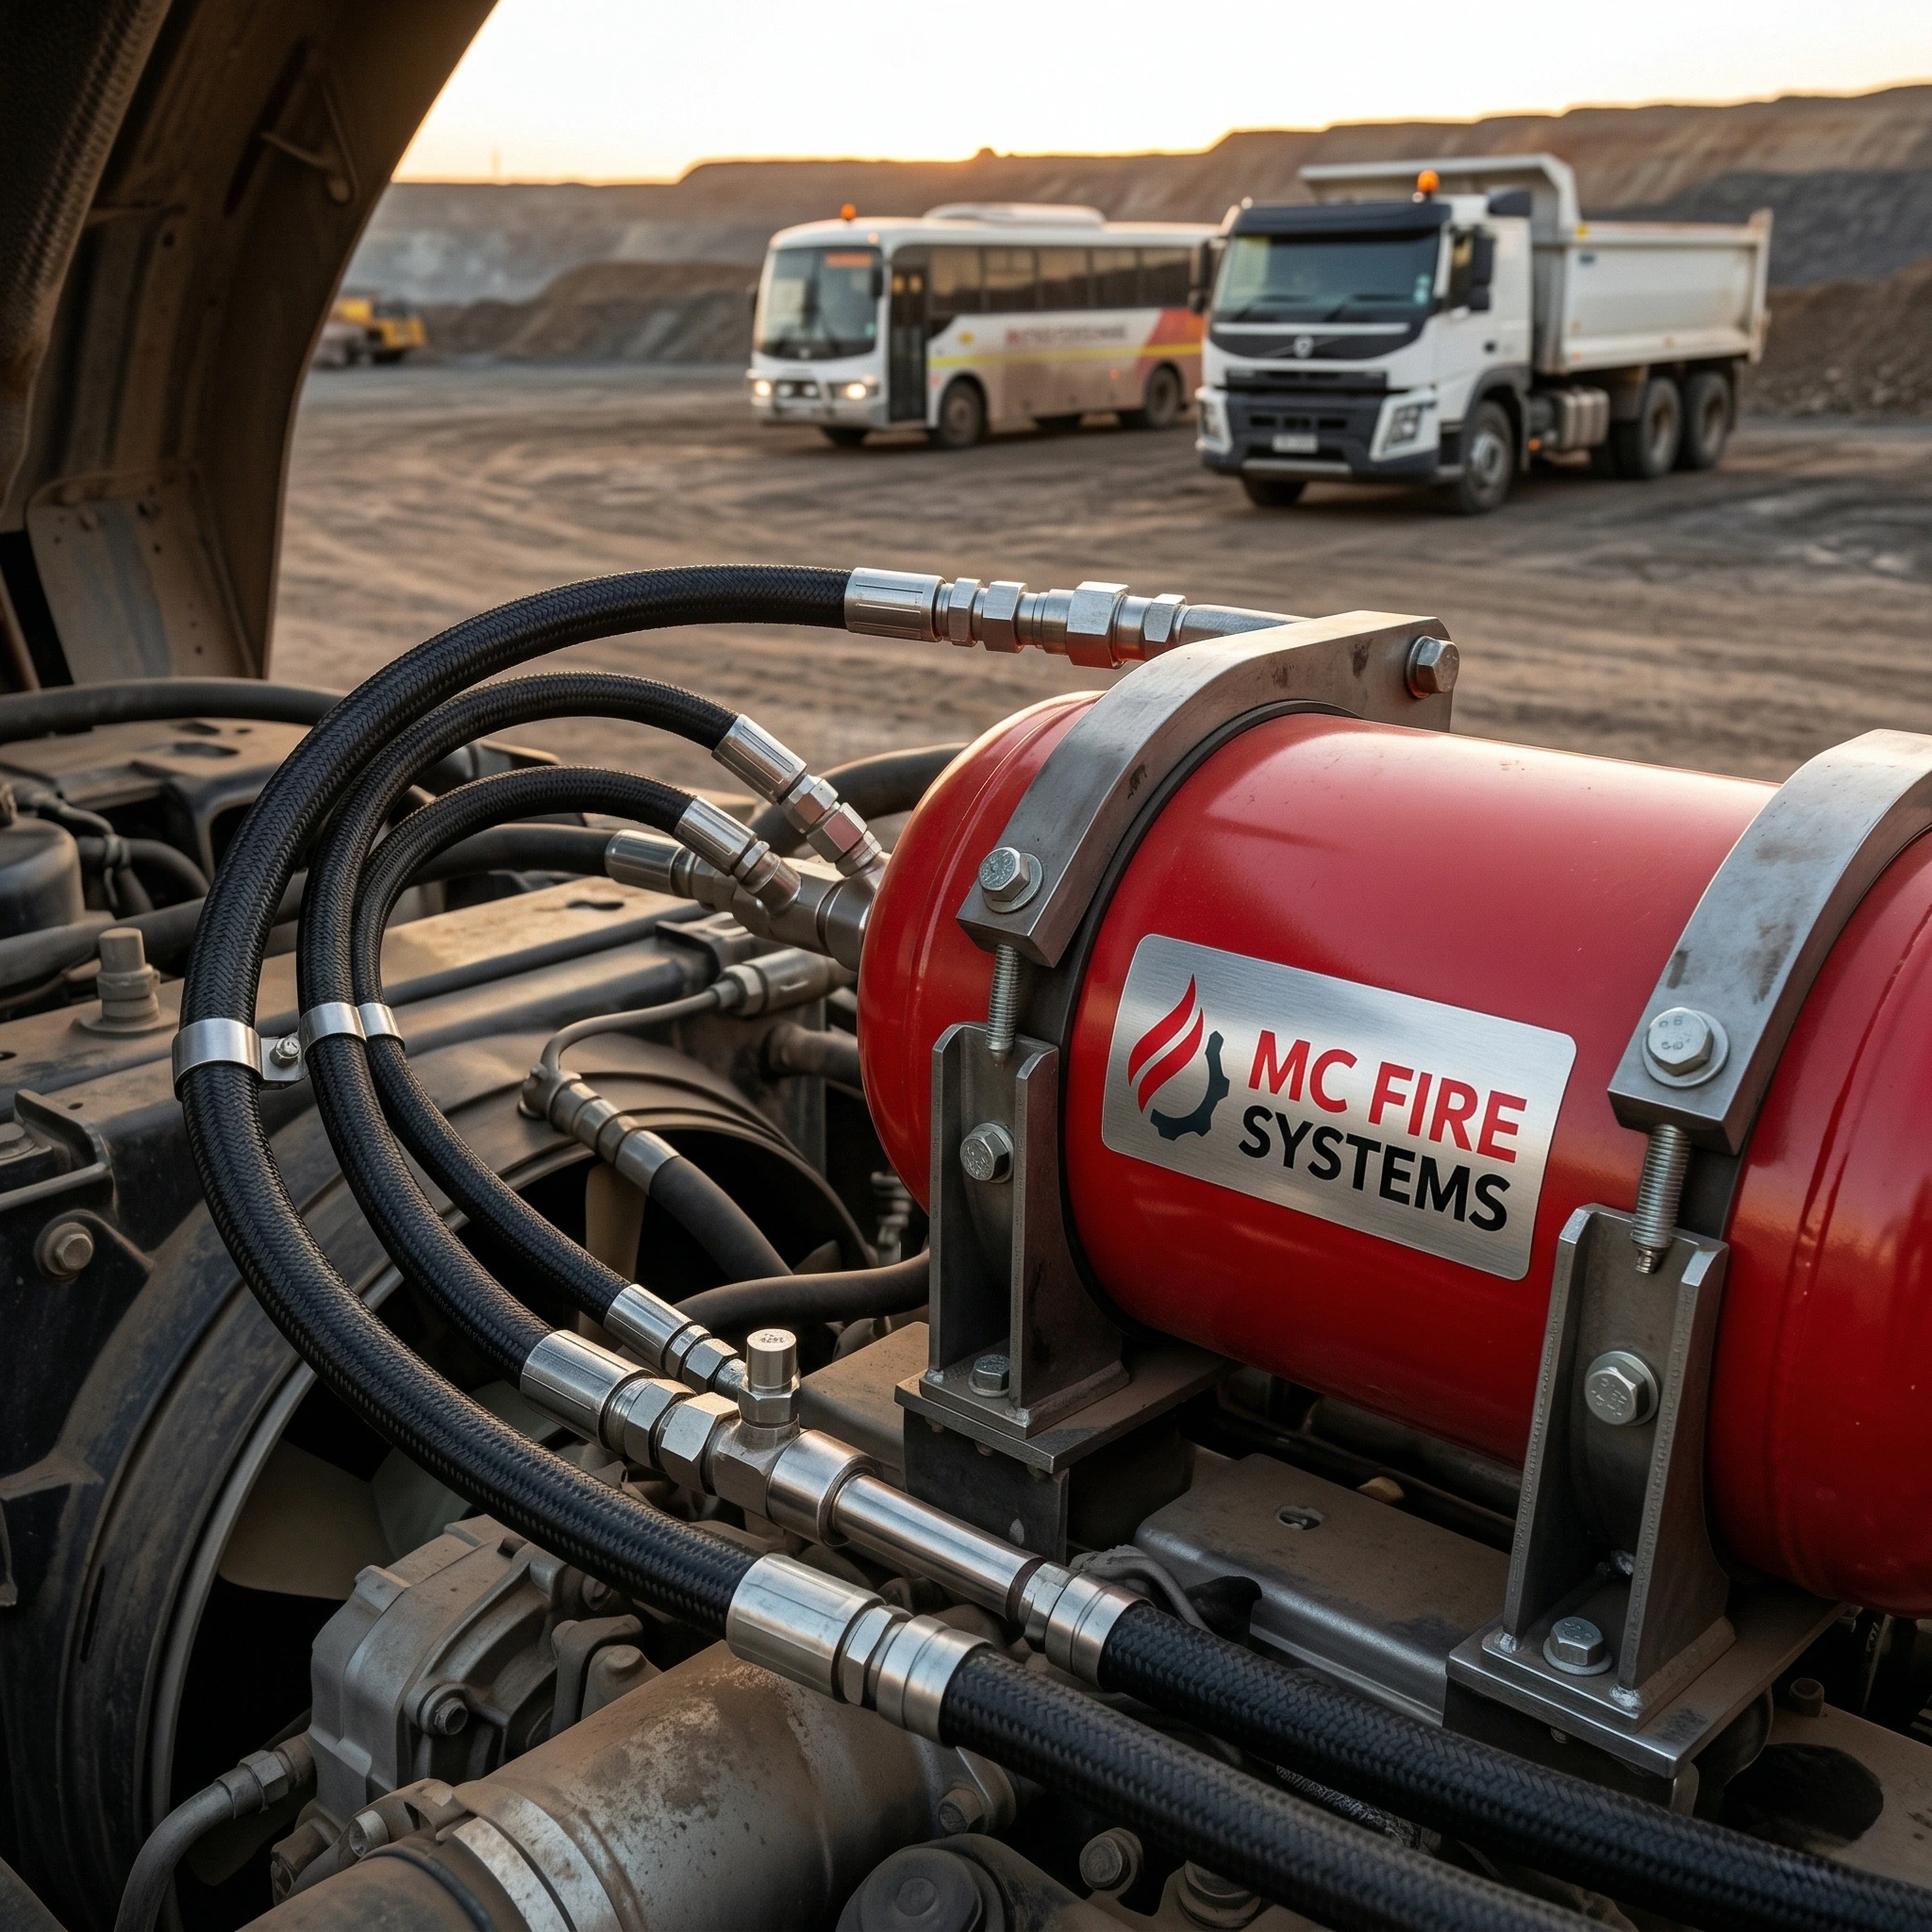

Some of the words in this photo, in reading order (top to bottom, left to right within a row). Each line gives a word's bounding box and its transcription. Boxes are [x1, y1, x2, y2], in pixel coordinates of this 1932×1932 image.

[1248, 1029, 1357, 1113] MC
[1368, 1061, 1527, 1163] FIRE
[1239, 1105, 1511, 1231] SYSTEMS
